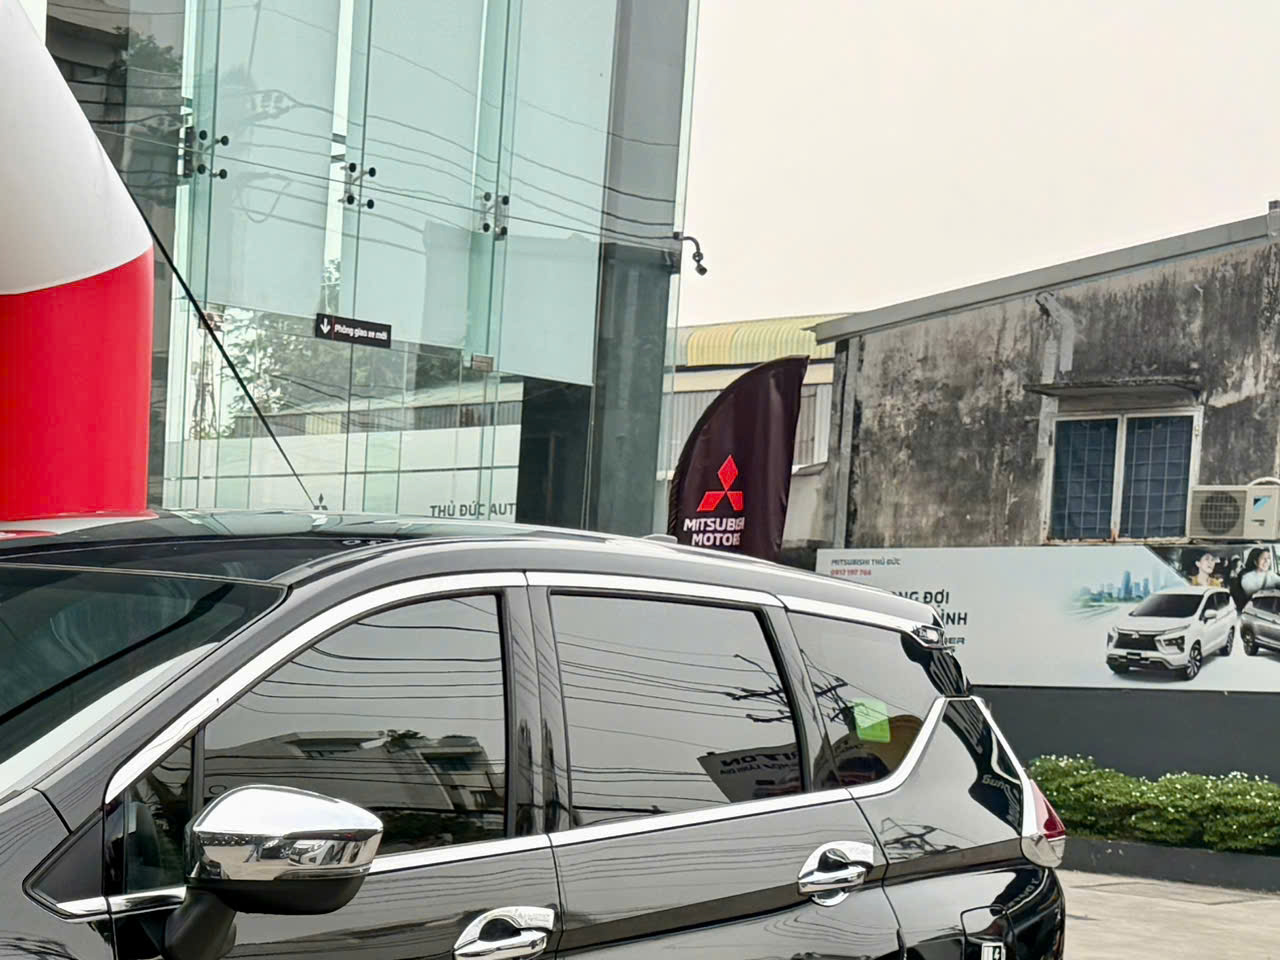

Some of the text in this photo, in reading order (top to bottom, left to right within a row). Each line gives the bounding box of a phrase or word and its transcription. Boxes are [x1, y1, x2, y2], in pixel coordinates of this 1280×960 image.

[429, 500, 456, 517] THỦ
[489, 503, 517, 516] AUT
[923, 589, 950, 607] ĐỢI
